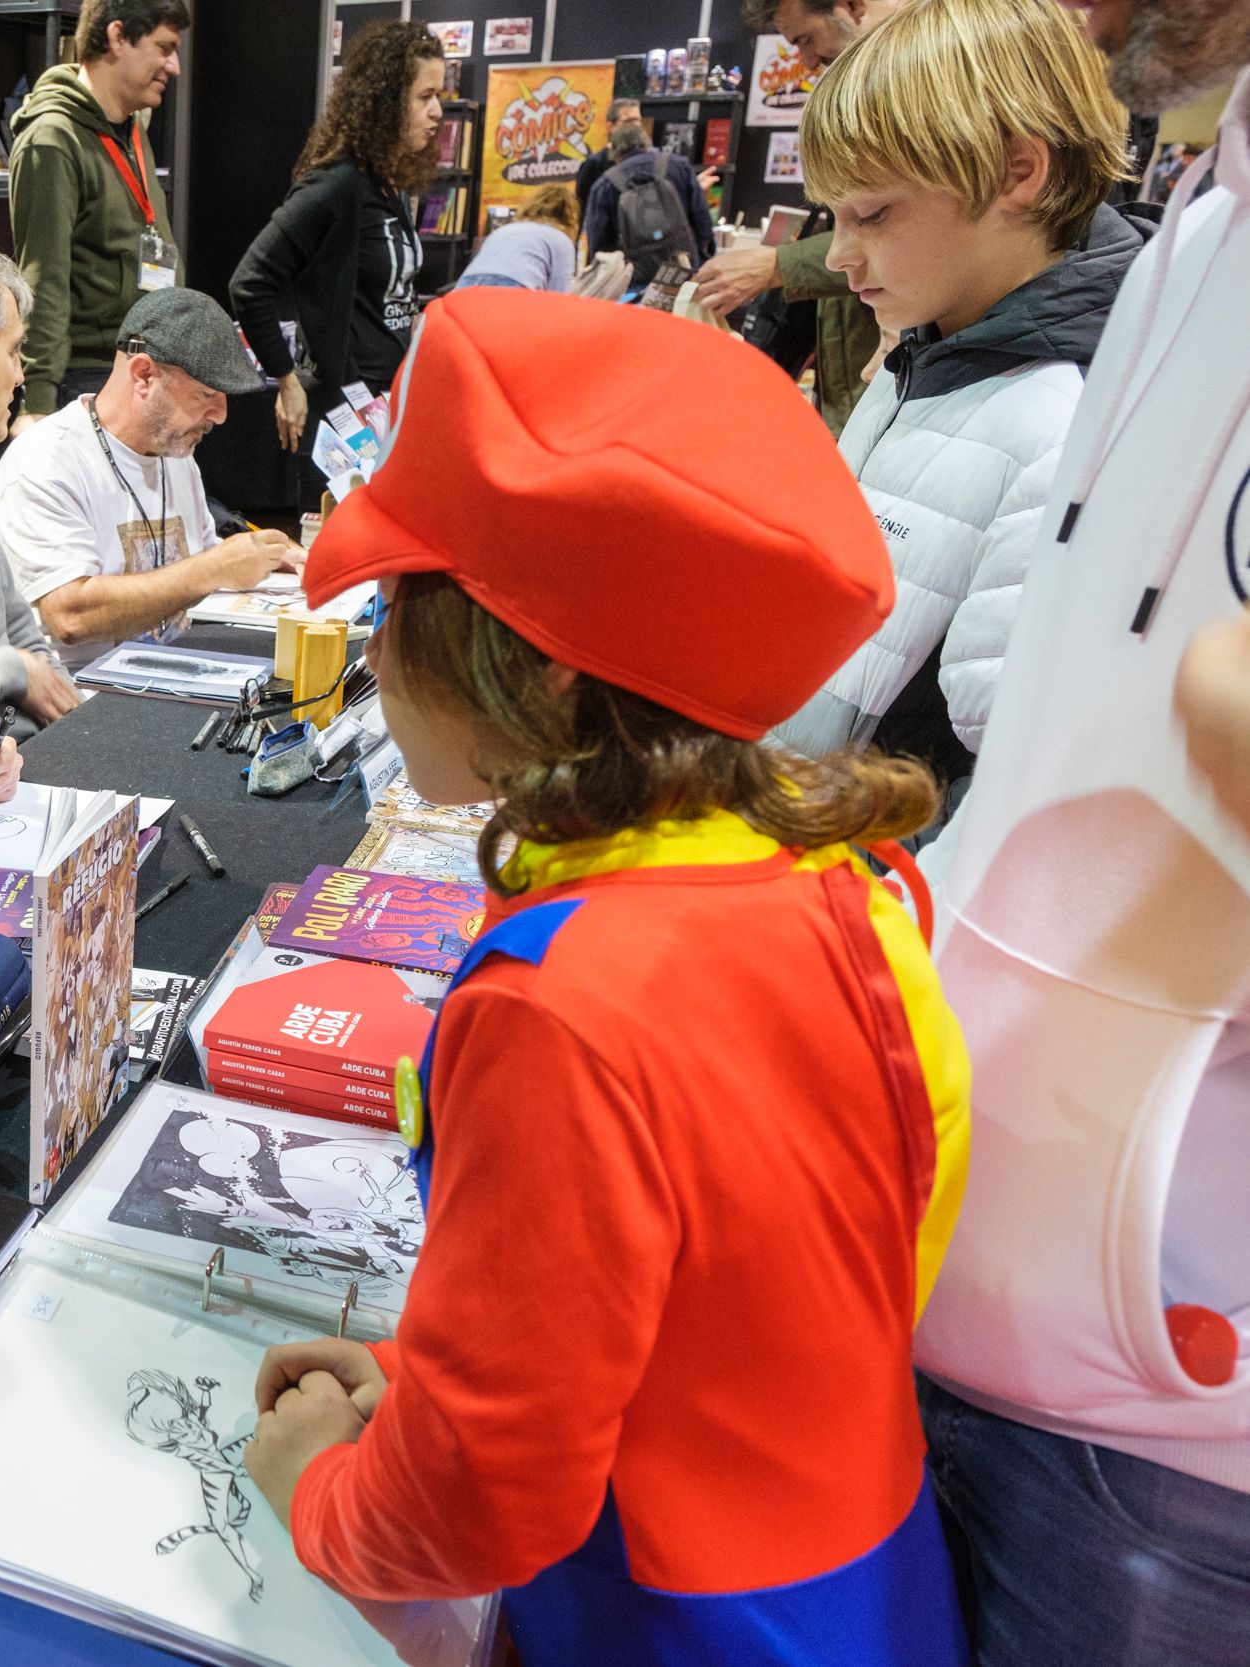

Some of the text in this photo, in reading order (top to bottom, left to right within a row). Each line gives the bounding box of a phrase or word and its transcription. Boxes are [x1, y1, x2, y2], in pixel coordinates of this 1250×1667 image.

[496, 102, 590, 159] COMICS
[62, 839, 123, 915] REFUGIO
[313, 872, 371, 906] RARO
[292, 904, 350, 941] POLI
[279, 1003, 322, 1039] ARDE
[308, 1010, 352, 1044] CUBA
[242, 1043, 262, 1052] FERRER
[263, 1047, 282, 1056] CASAS
[246, 1065, 266, 1074] FERRER
[267, 1069, 285, 1078] CASAS
[341, 1062, 386, 1078] ARDE CUBA
[246, 1082, 265, 1091] FERRER
[266, 1086, 284, 1095] CASAS
[345, 1084, 390, 1100] ARDE CUBA
[343, 1103, 388, 1119] ARDE CUBA
